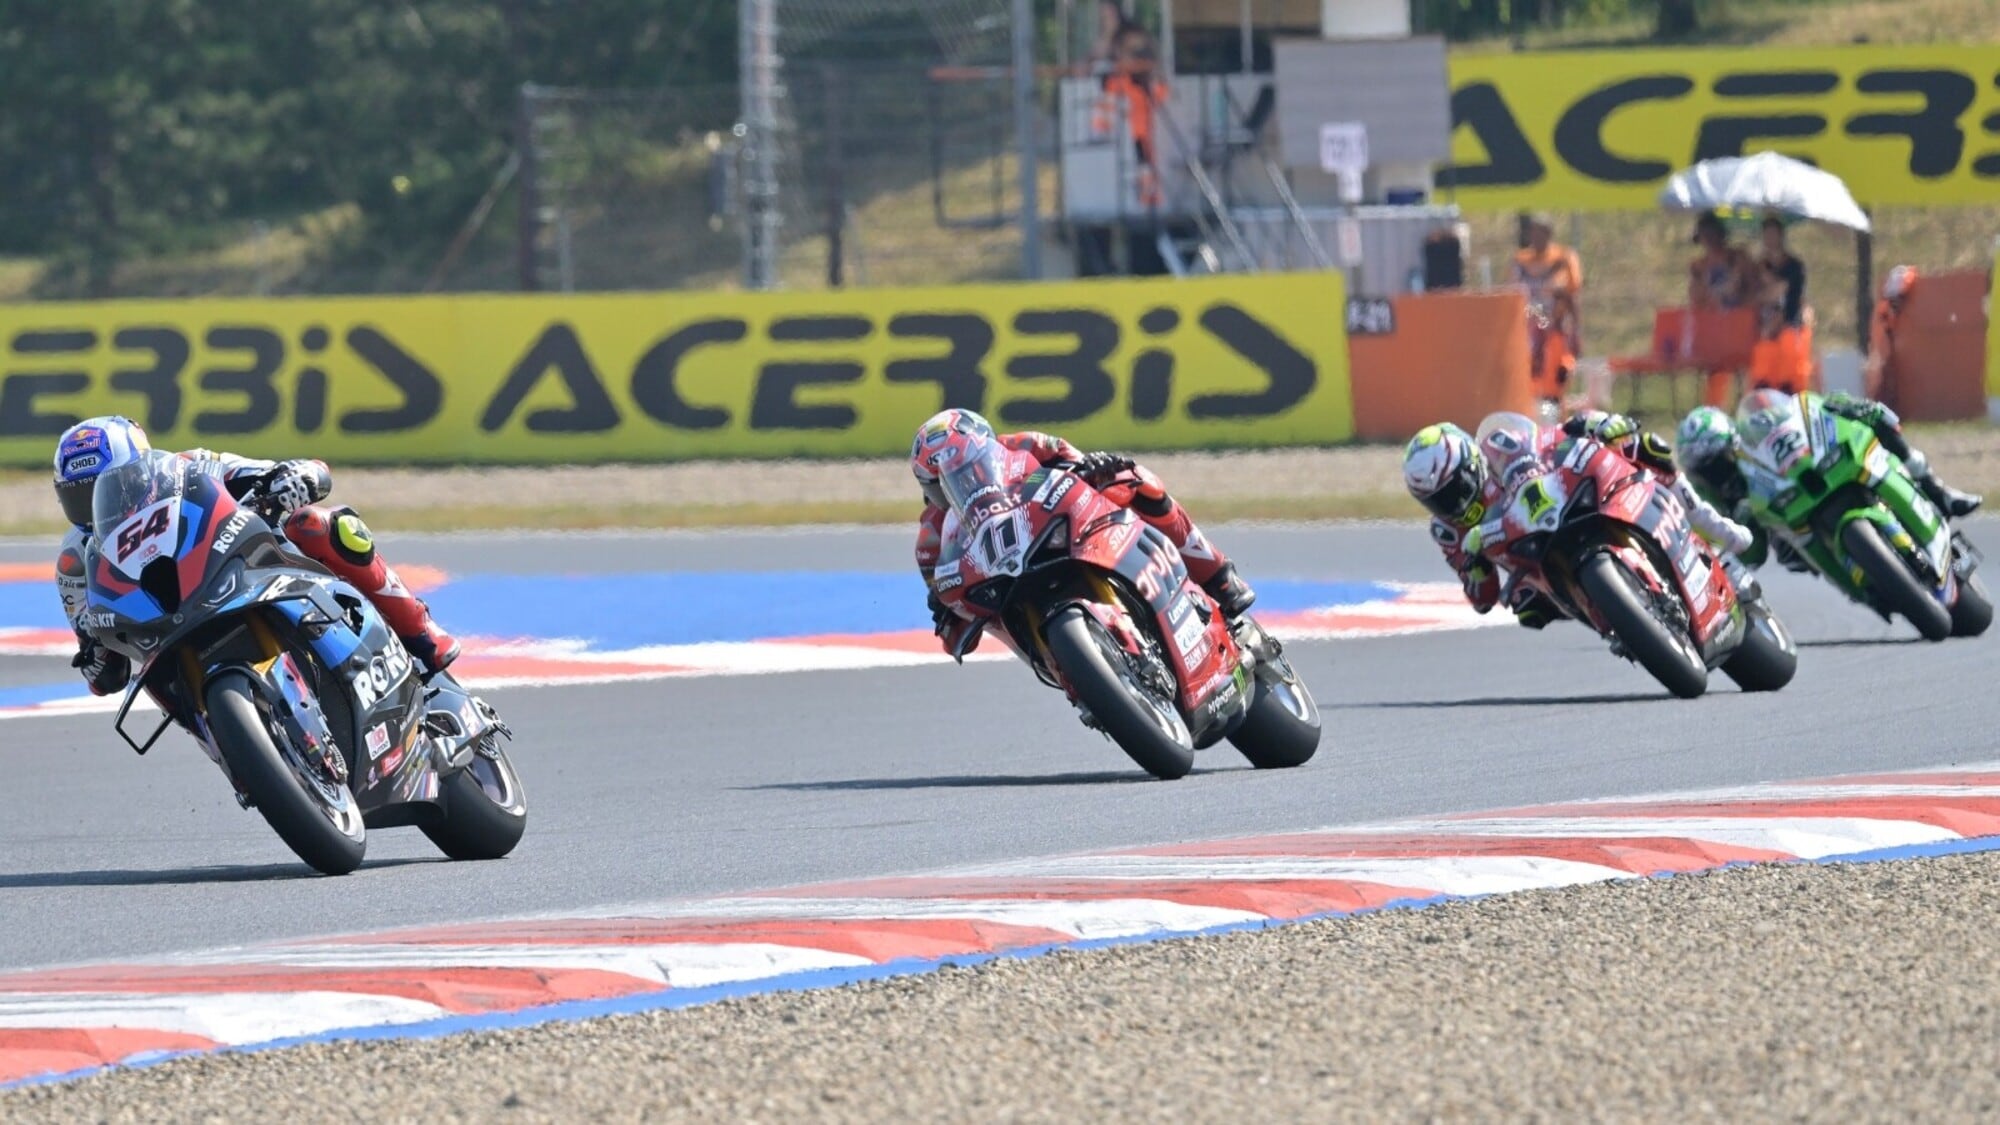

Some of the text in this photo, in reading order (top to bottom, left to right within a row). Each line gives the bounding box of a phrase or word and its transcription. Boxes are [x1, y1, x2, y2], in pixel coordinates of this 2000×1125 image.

[71, 456, 97, 471] SHOEI
[1771, 430, 1801, 463] 22
[1043, 476, 1075, 511] Lenovo
[117, 504, 171, 565] 54
[981, 514, 1020, 572] 11
